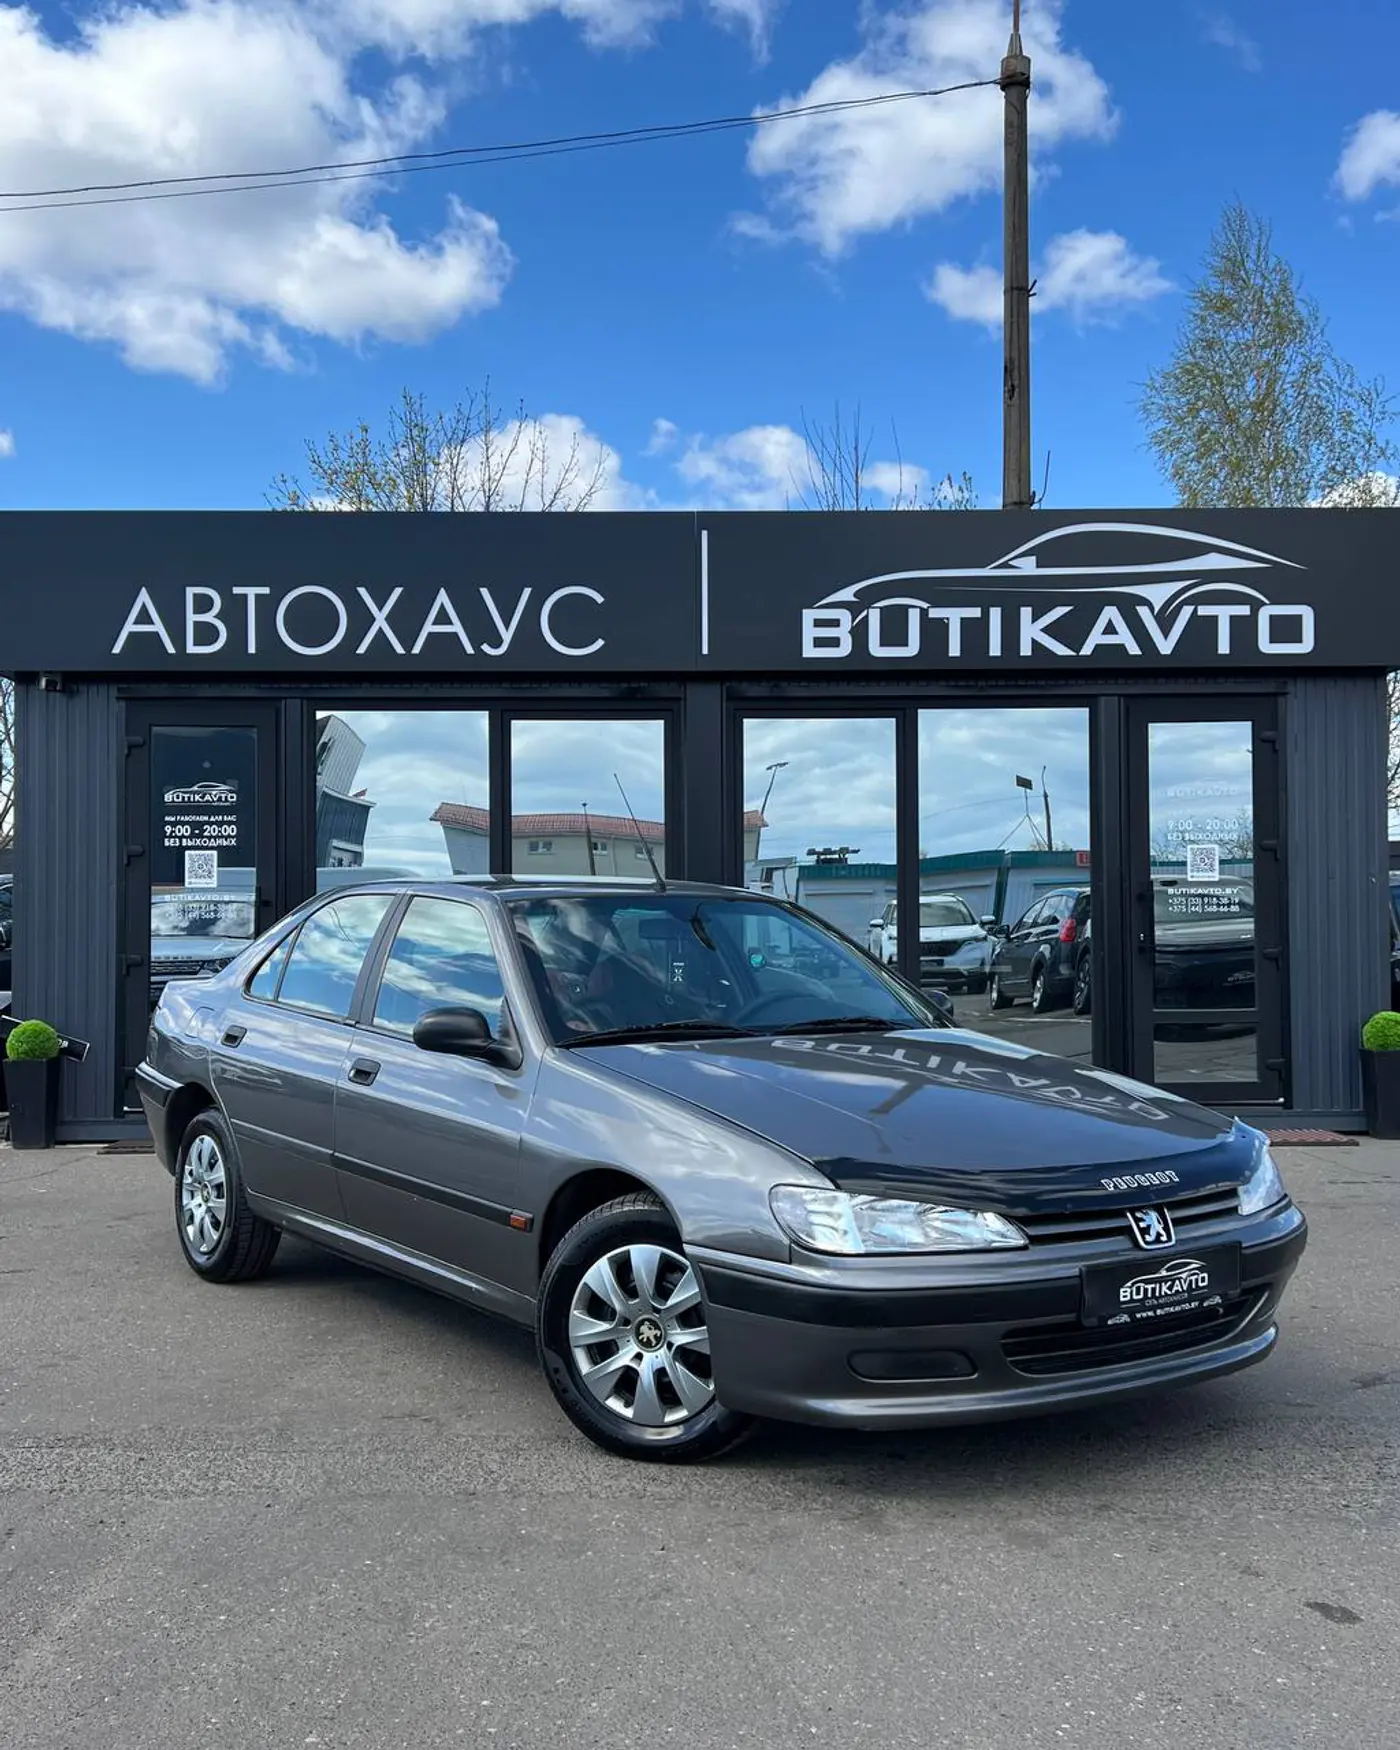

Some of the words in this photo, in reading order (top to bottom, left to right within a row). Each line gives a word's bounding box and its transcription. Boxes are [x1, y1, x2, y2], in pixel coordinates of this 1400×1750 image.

[111, 585, 605, 656] АВТОХАУС
[802, 604, 1315, 658] BUTIKAVTO
[164, 793, 237, 802] BUTIKAVTO
[164, 825, 191, 836] 9:00
[203, 825, 237, 836] 20:00
[1205, 819, 1239, 830] 20:00
[164, 838, 180, 846] БЕЗ
[182, 838, 237, 847] ВЫХОДНЫХ
[1101, 1170, 1180, 1191] PEUGEOT
[1119, 1272, 1208, 1302] BUTIKAVTO
